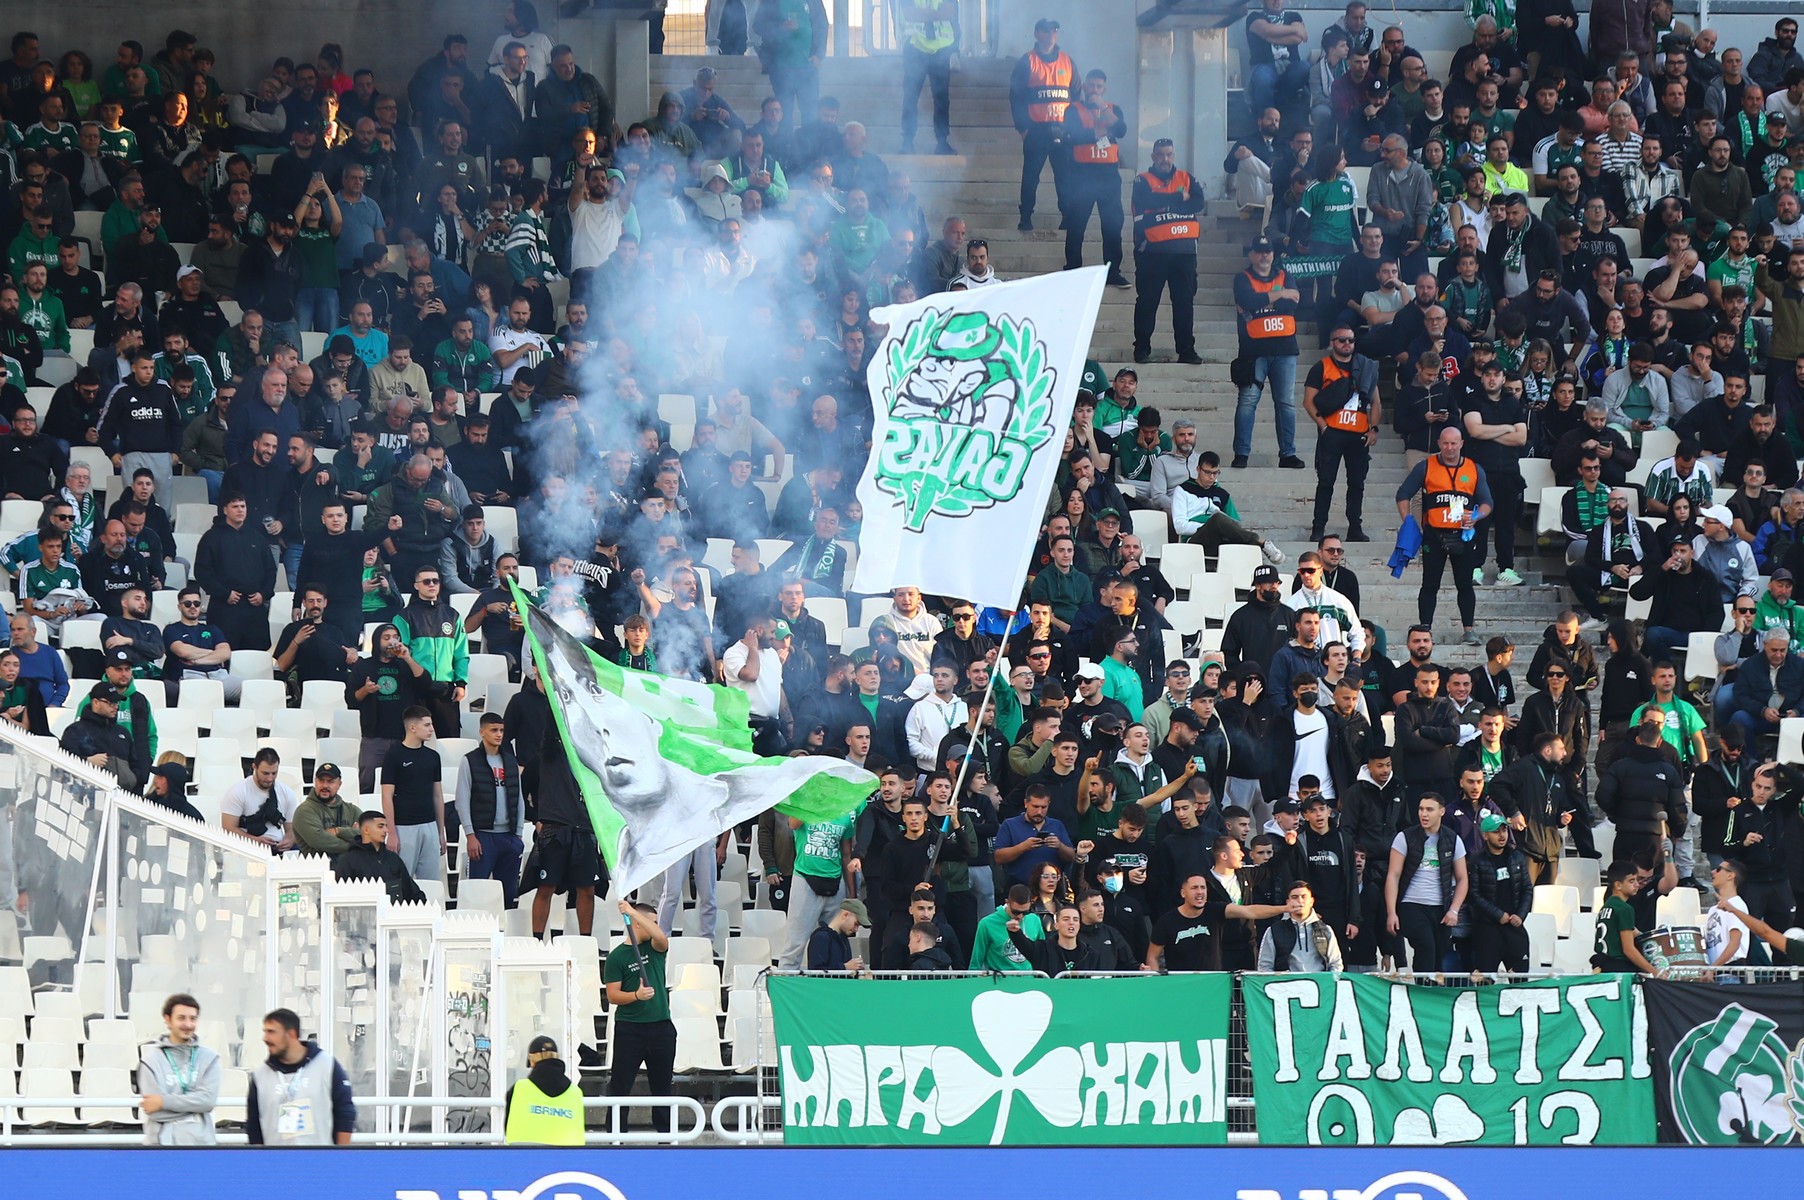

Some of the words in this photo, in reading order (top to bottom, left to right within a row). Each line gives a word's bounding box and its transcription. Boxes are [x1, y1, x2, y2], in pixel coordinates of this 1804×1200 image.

[1170, 224, 1188, 235] 099
[1282, 260, 1341, 274] ANATHINAI
[1263, 317, 1285, 332] 085
[1338, 410, 1358, 426] 104
